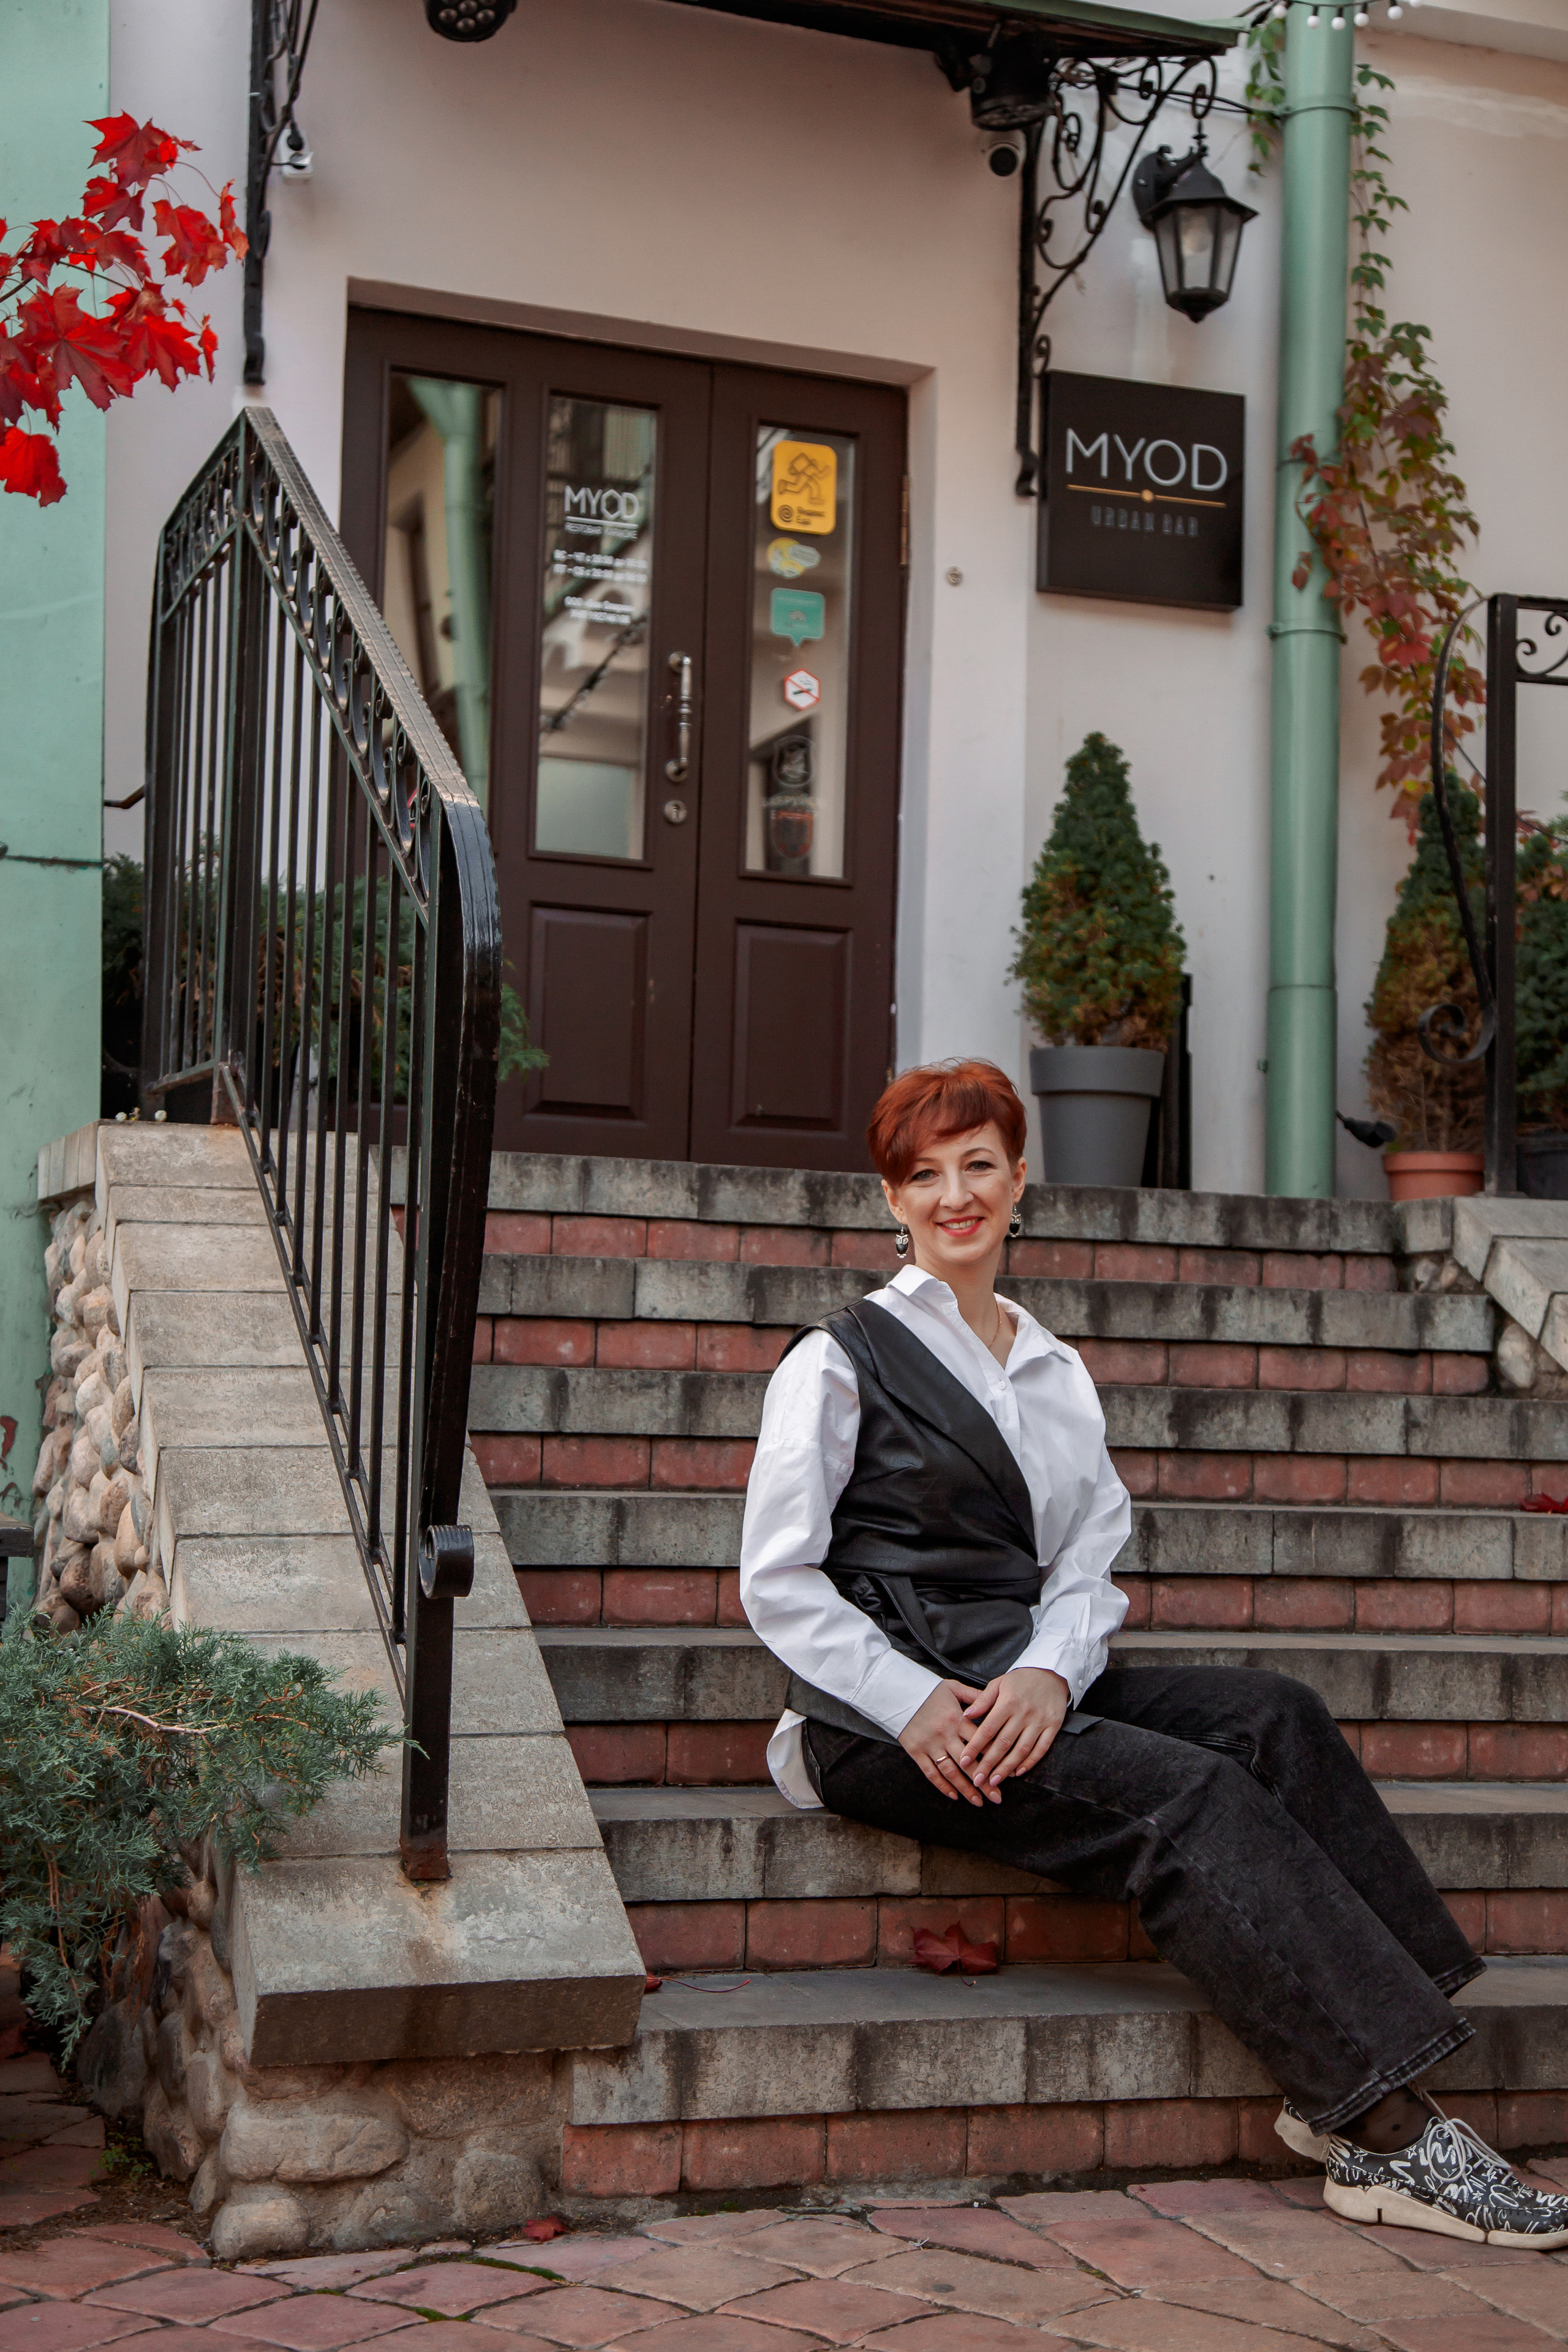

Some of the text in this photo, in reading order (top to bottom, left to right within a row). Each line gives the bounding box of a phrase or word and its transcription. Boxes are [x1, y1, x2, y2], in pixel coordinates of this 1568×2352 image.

[1065, 428, 1228, 491] MYOD
[564, 485, 639, 520] MYOD
[1091, 505, 1198, 538] URBAN BAR
